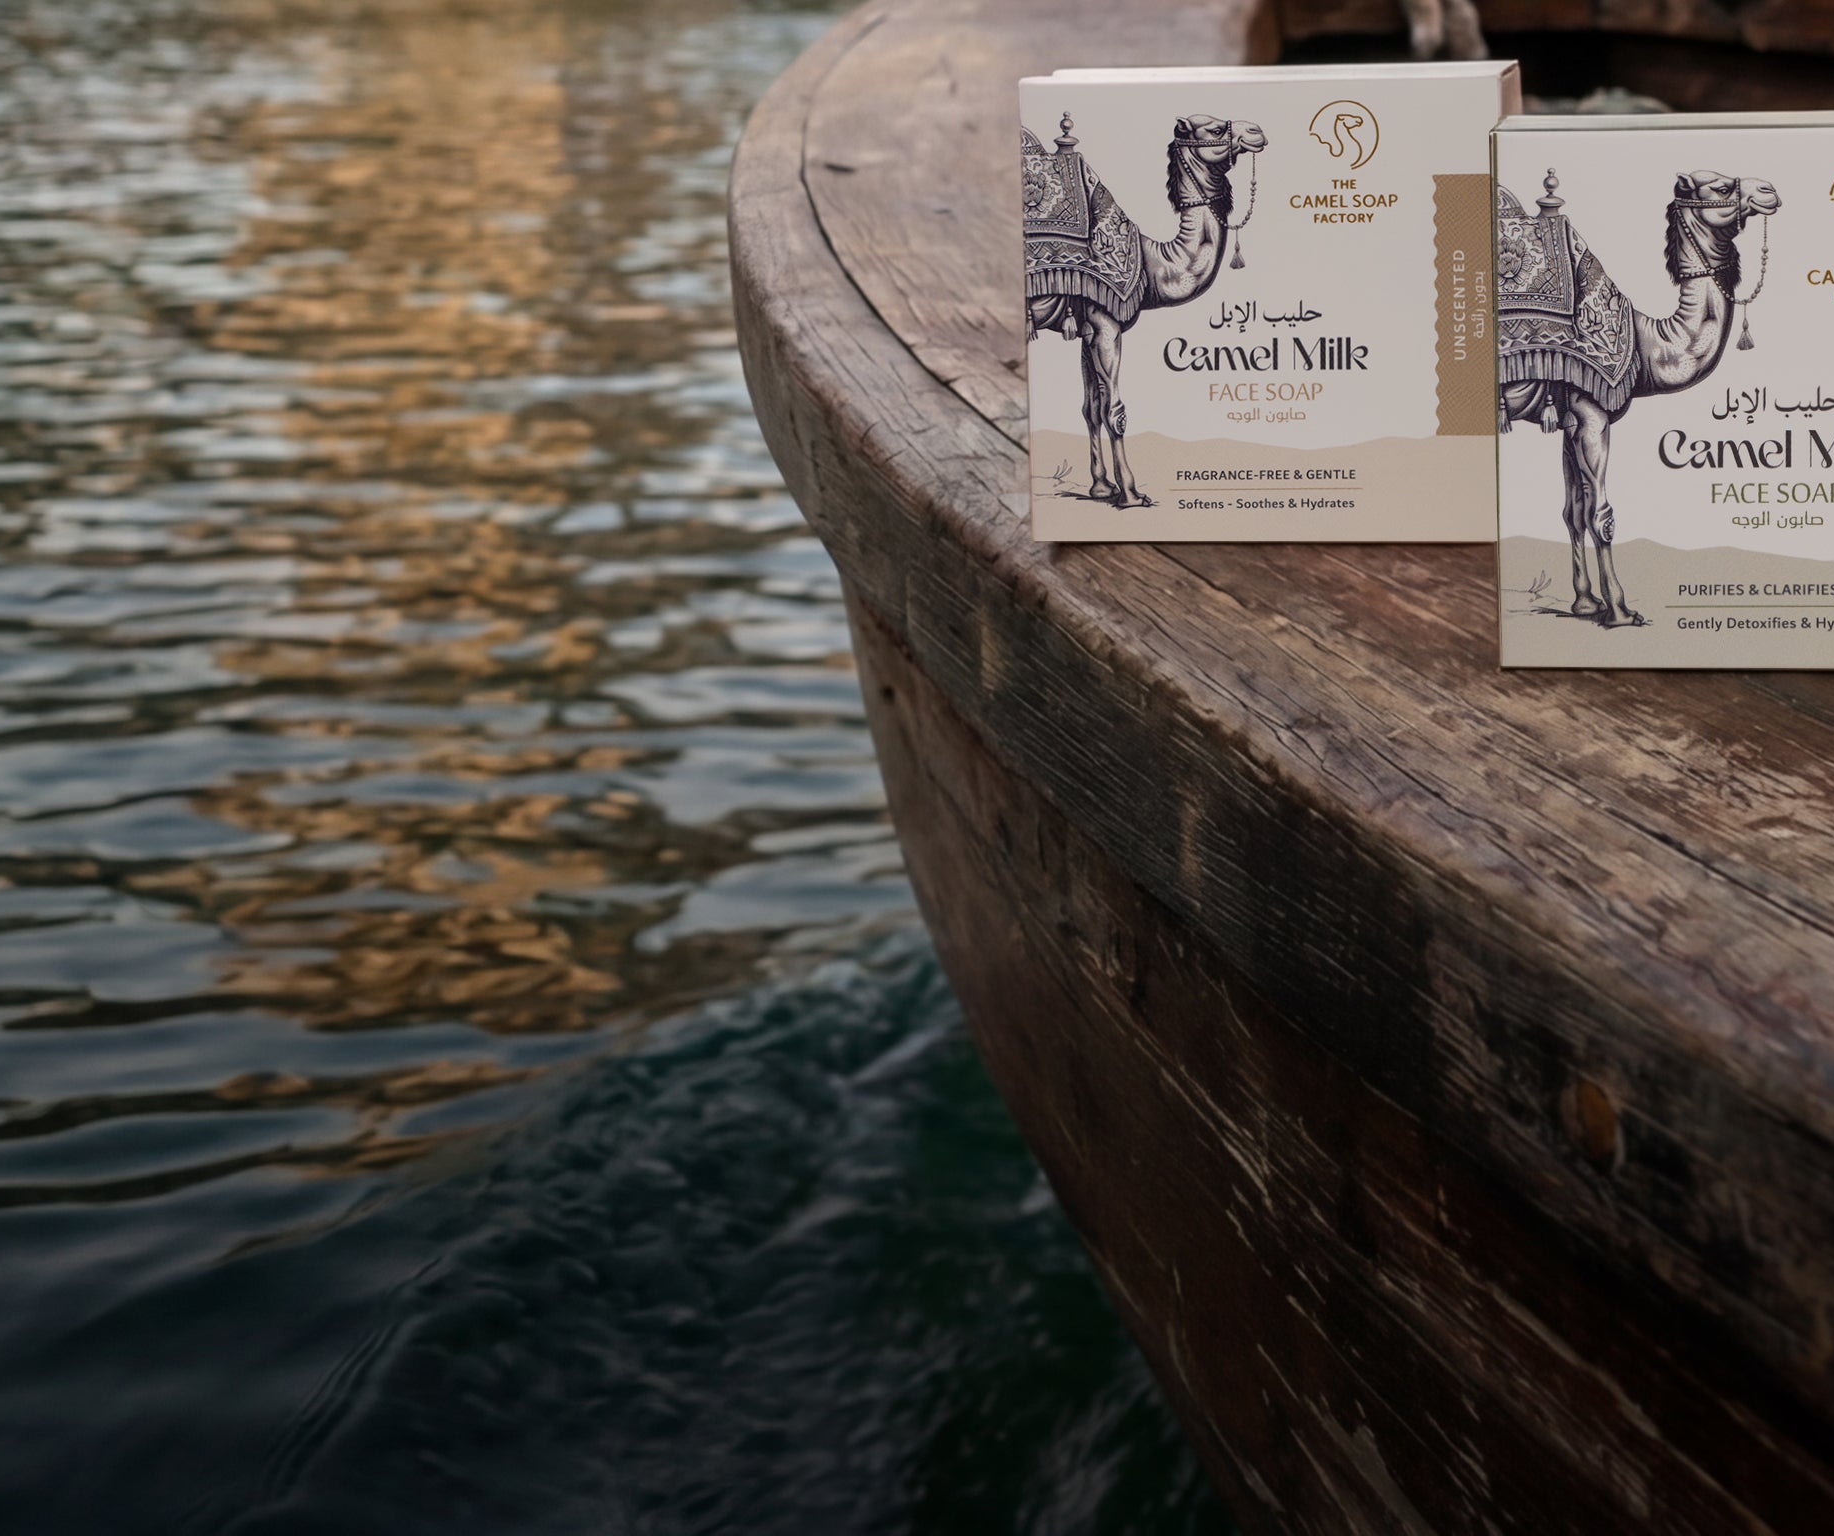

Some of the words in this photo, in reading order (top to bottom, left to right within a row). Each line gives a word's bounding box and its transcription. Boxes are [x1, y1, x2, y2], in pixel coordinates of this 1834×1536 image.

[1331, 179, 1357, 190] THE
[1289, 194, 1348, 209] CAMEL
[1352, 193, 1398, 208] SOAP
[1313, 213, 1374, 224] FACTORY
[1475, 271, 1487, 304] بدون
[1263, 300, 1323, 328] حليب
[1453, 249, 1467, 361] UNSCENTED
[1209, 300, 1257, 334] الإبل
[1470, 308, 1486, 339] رائحة
[1163, 337, 1279, 372] Camel
[1292, 336, 1369, 371] Milk
[1208, 383, 1259, 402] FACE
[1265, 382, 1323, 401] SOAP
[1711, 386, 1767, 425] الإبل
[1226, 407, 1260, 424] الوجه
[1265, 407, 1307, 423] صابون
[1658, 429, 1792, 469] Camel
[1176, 469, 1290, 481] FRAGRANCE-FREE
[1293, 469, 1303, 480] &
[1306, 469, 1356, 480] GENTLE
[1711, 482, 1769, 504] FACE
[1178, 498, 1224, 510] Softens
[1236, 498, 1285, 509] Soothes
[1288, 498, 1298, 509] &
[1300, 497, 1355, 511] Hydrates
[1732, 511, 1770, 529] الوجه
[1776, 511, 1824, 529] صابون
[1678, 584, 1744, 596] PURIFIES
[1749, 584, 1759, 595] &
[1677, 617, 1722, 632] Gently
[1727, 616, 1797, 629] Detoxifies
[1800, 617, 1811, 629] &
